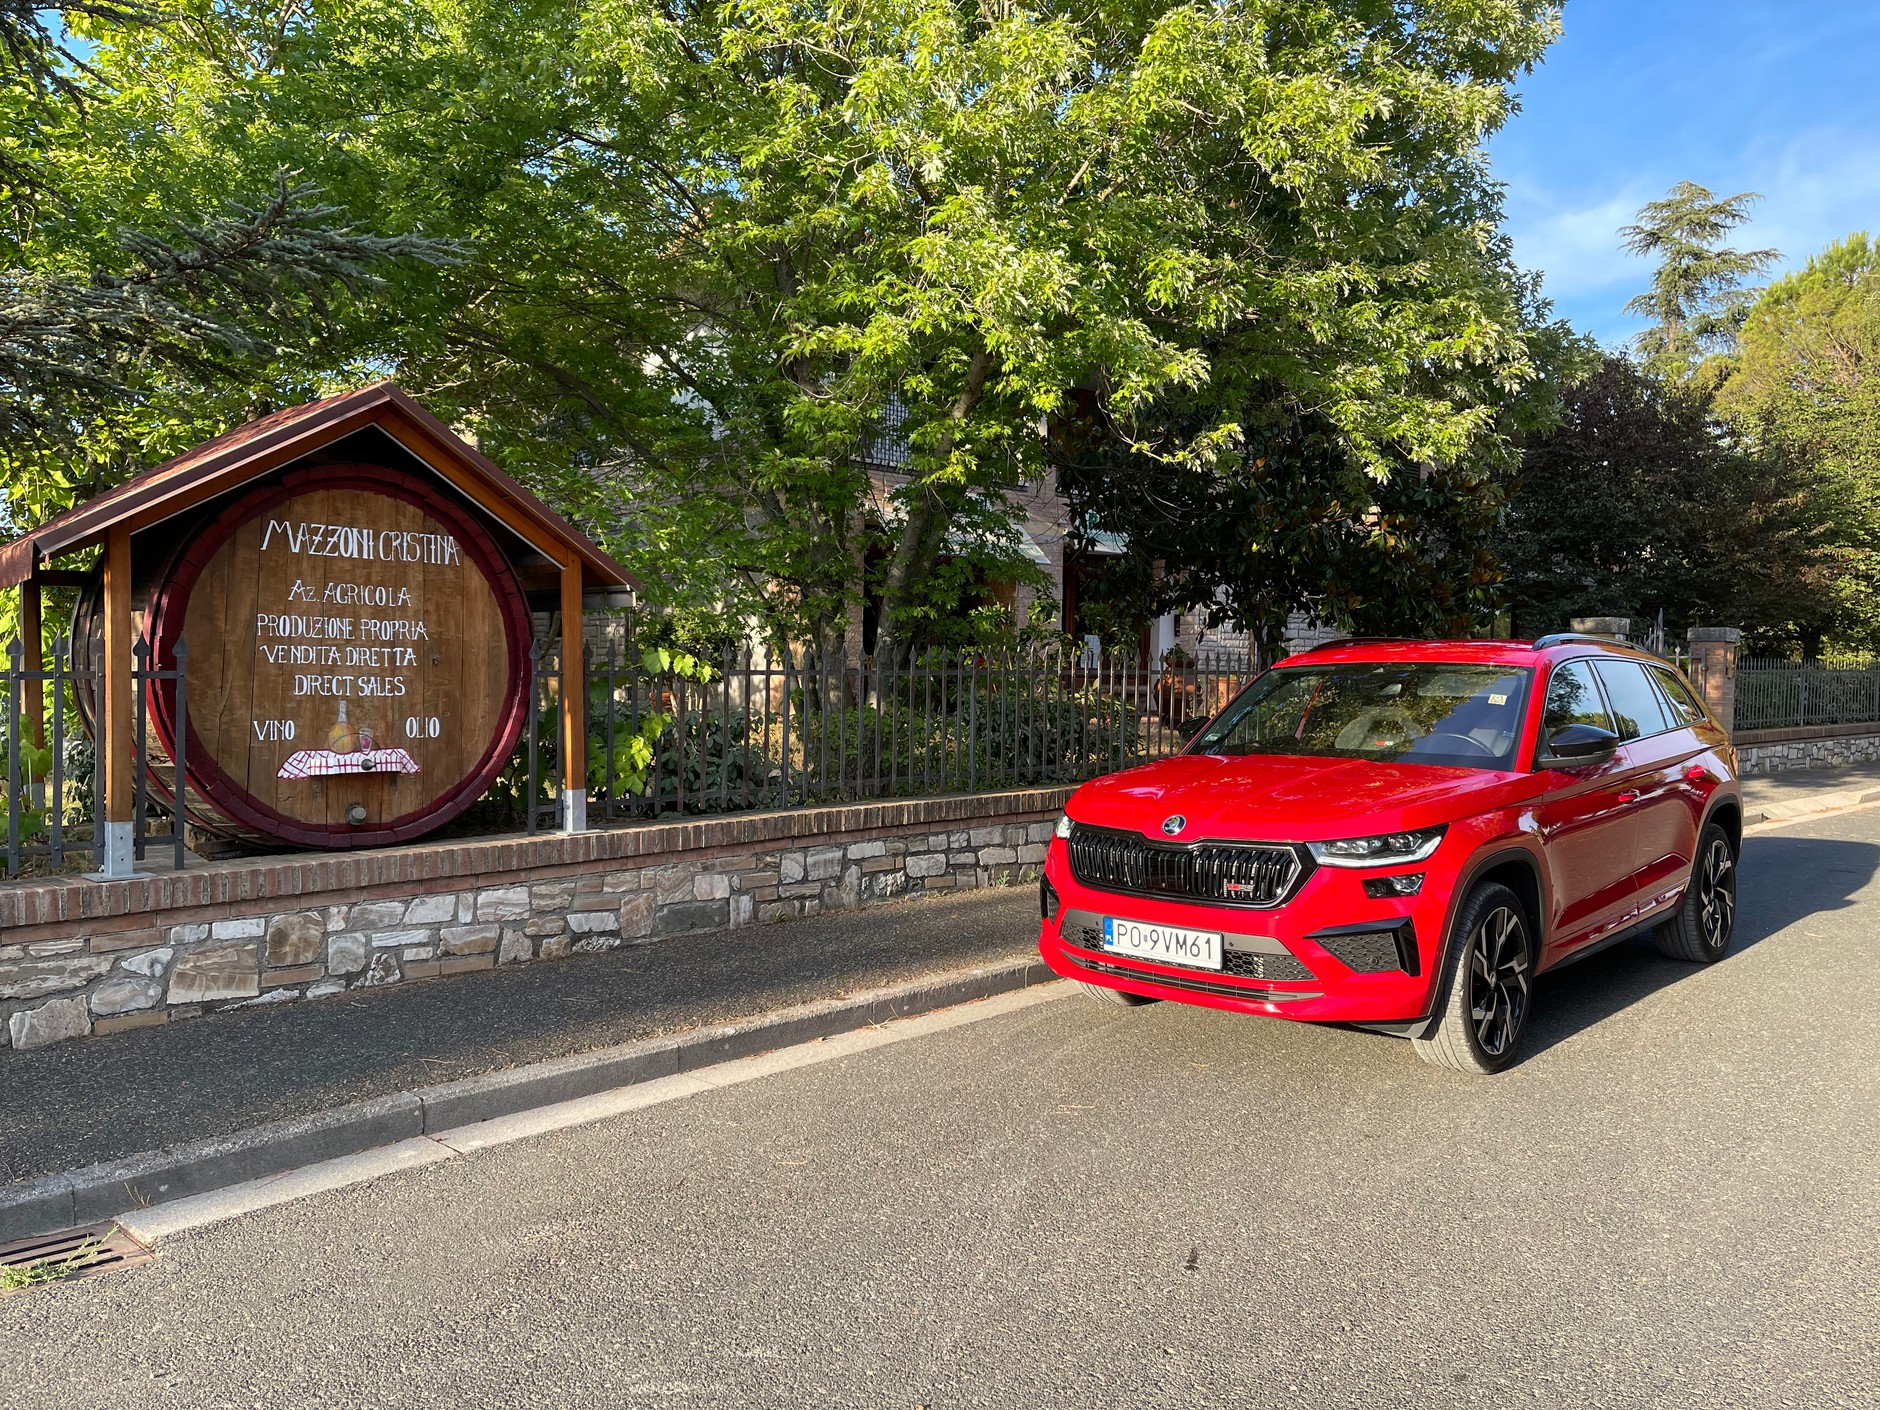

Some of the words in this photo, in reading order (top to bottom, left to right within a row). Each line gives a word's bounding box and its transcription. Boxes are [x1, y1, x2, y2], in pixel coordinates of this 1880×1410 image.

[260, 519, 375, 559] MAZZONI
[379, 530, 461, 566] CRISTINA
[323, 582, 412, 607] AGRICOLA
[257, 613, 355, 639] PRODUZIONE
[360, 619, 429, 641] PROPRIA
[259, 645, 341, 665] VENDITA
[345, 647, 418, 667] DIRETTA
[294, 675, 354, 696] DIRECT
[358, 677, 406, 697] SALES
[253, 720, 296, 741] VINO
[405, 716, 441, 739] OLIO
[1149, 929, 1212, 960] 9VM61
